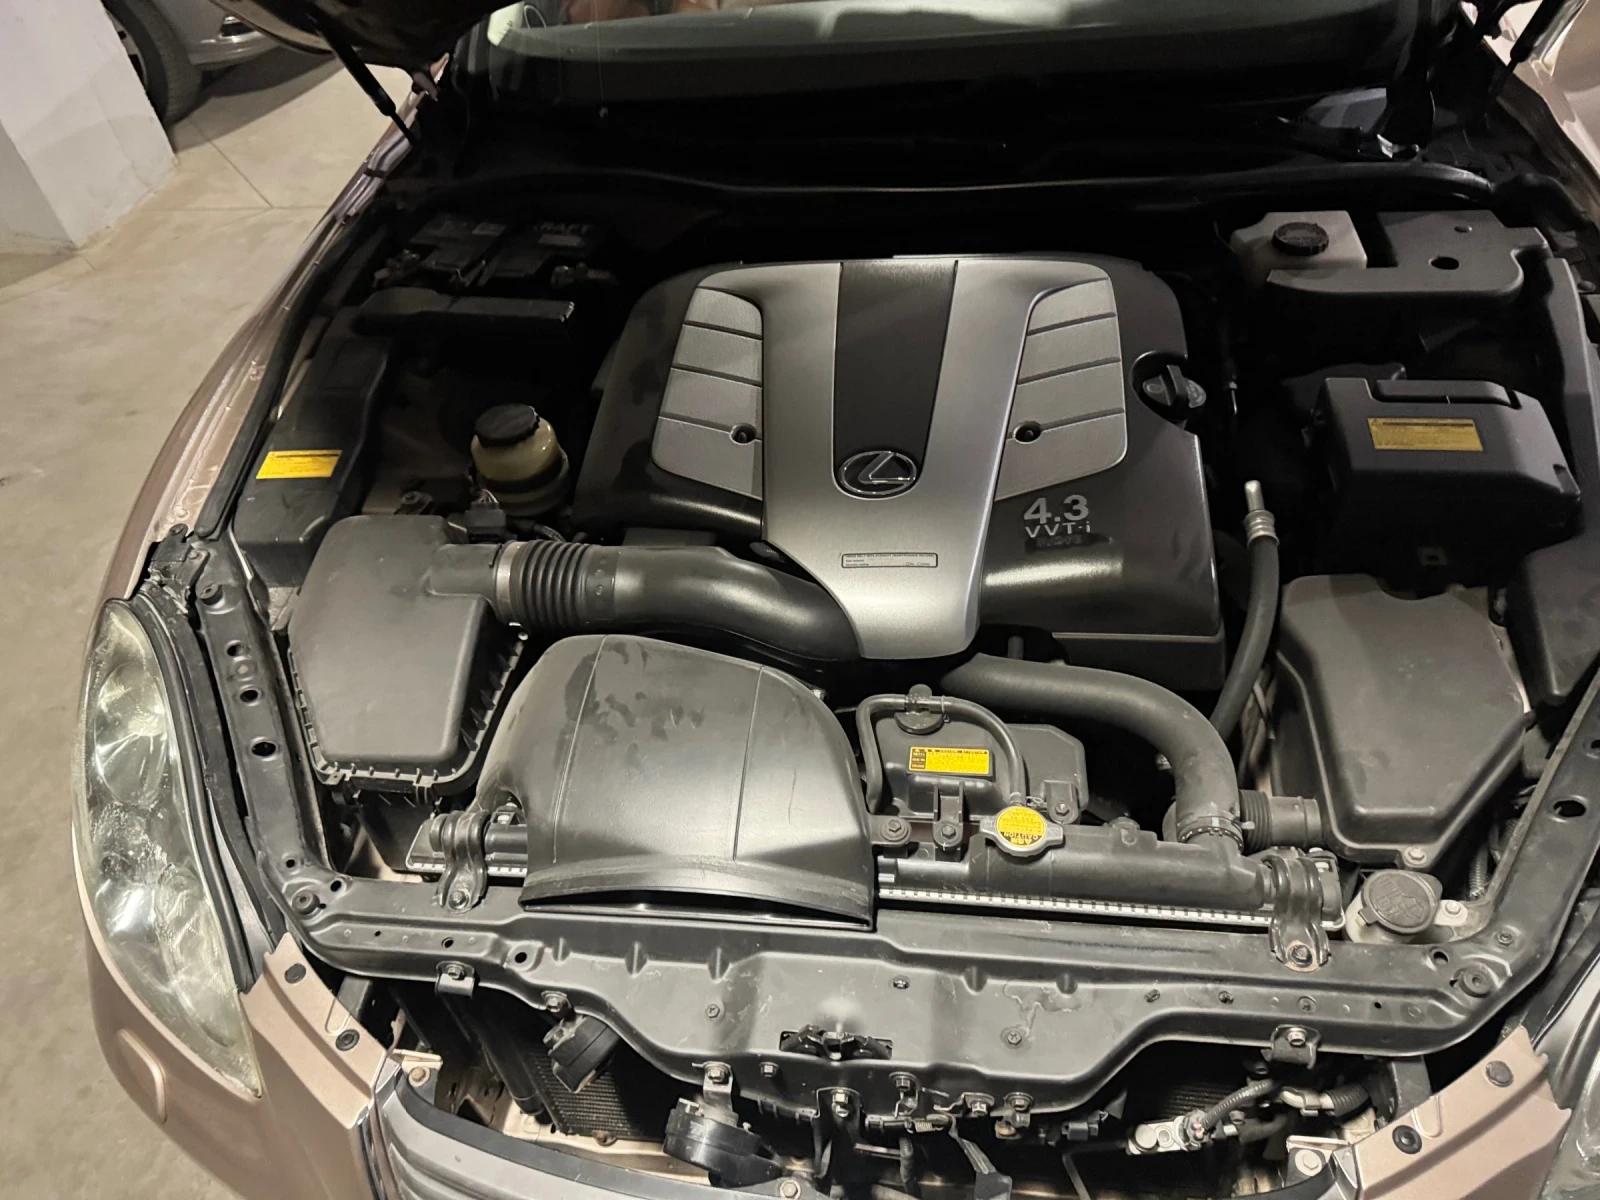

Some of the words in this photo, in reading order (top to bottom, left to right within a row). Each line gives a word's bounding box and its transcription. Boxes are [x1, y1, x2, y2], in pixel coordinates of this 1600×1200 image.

[1023, 494, 1089, 524] 4.3
[1024, 520, 1091, 538] VVT-i
[1004, 832, 1038, 840] CAUTION
